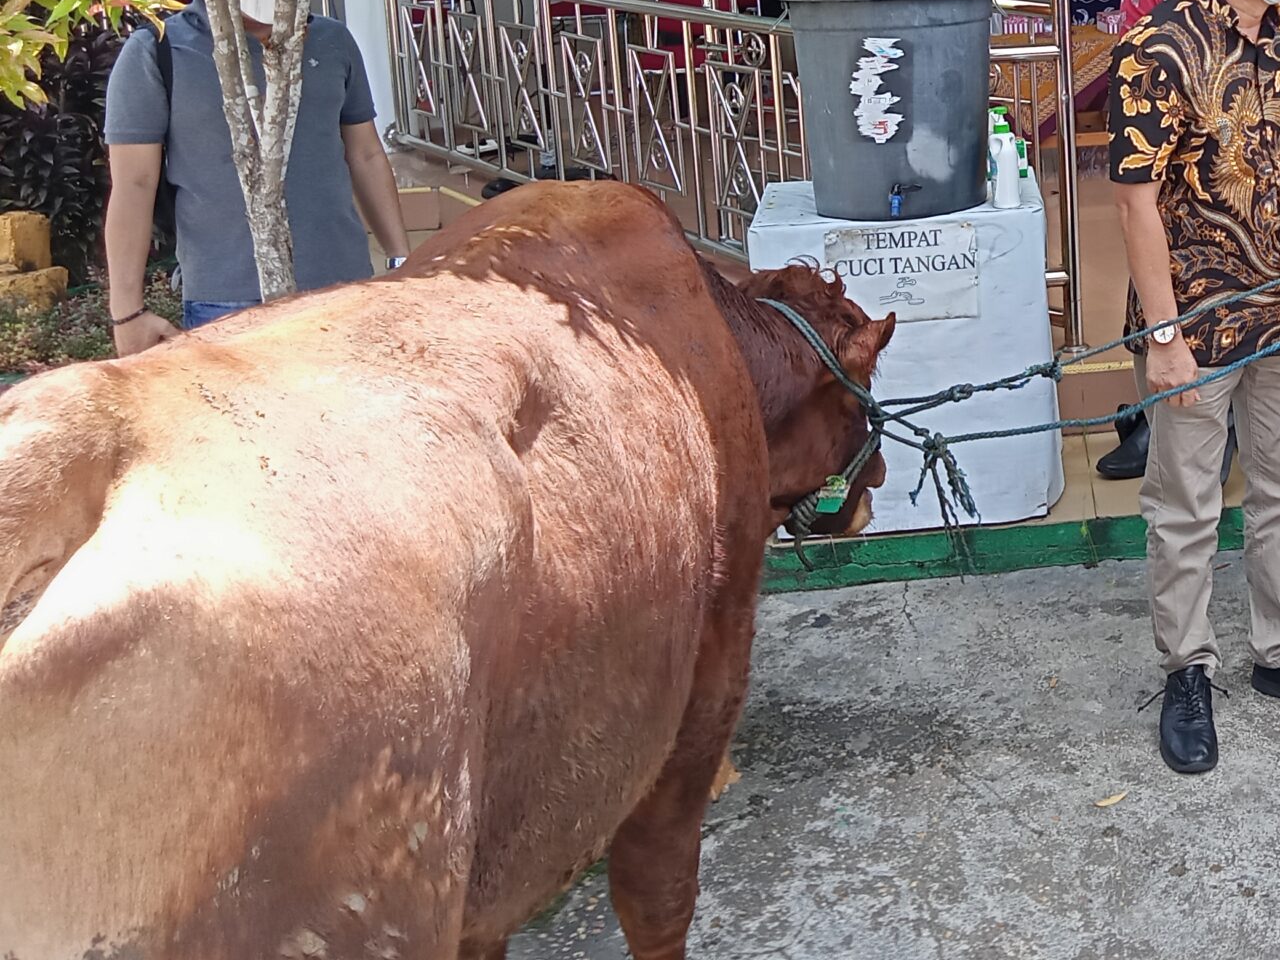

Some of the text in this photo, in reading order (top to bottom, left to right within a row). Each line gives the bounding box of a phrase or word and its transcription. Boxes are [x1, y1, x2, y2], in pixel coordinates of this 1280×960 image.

[862, 228, 942, 252] TEMPAT
[834, 252, 977, 278] CUCI TANGAN
